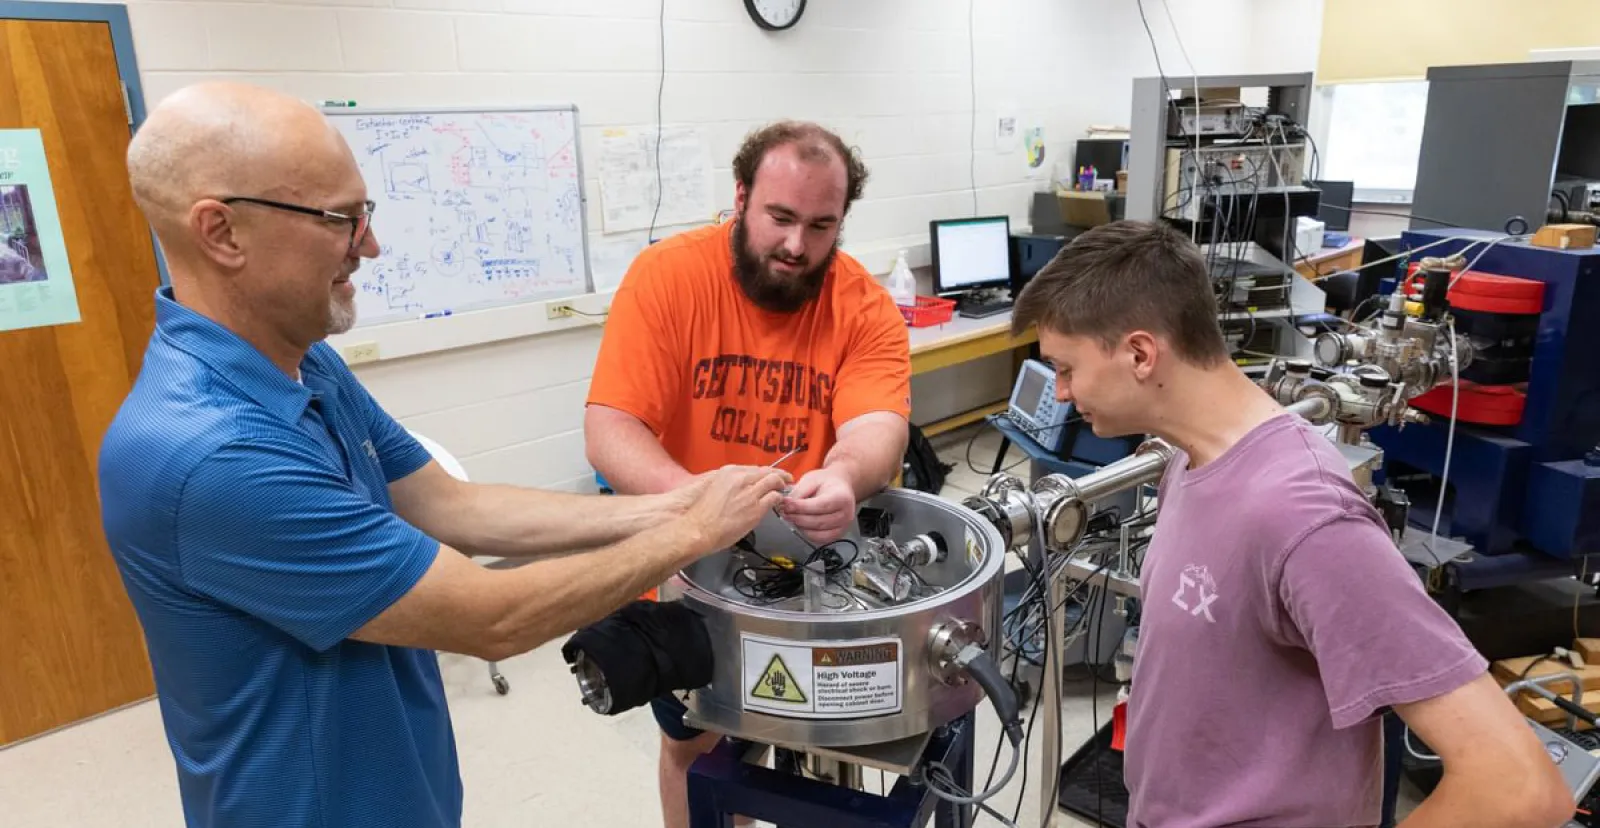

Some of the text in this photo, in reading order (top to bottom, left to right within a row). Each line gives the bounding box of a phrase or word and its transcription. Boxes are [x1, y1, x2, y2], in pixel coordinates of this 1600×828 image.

[693, 354, 833, 414] GETTYSBURG
[711, 405, 810, 453] COLLEGE
[836, 647, 893, 664] WARNING
[817, 670, 877, 680] High Voltage
